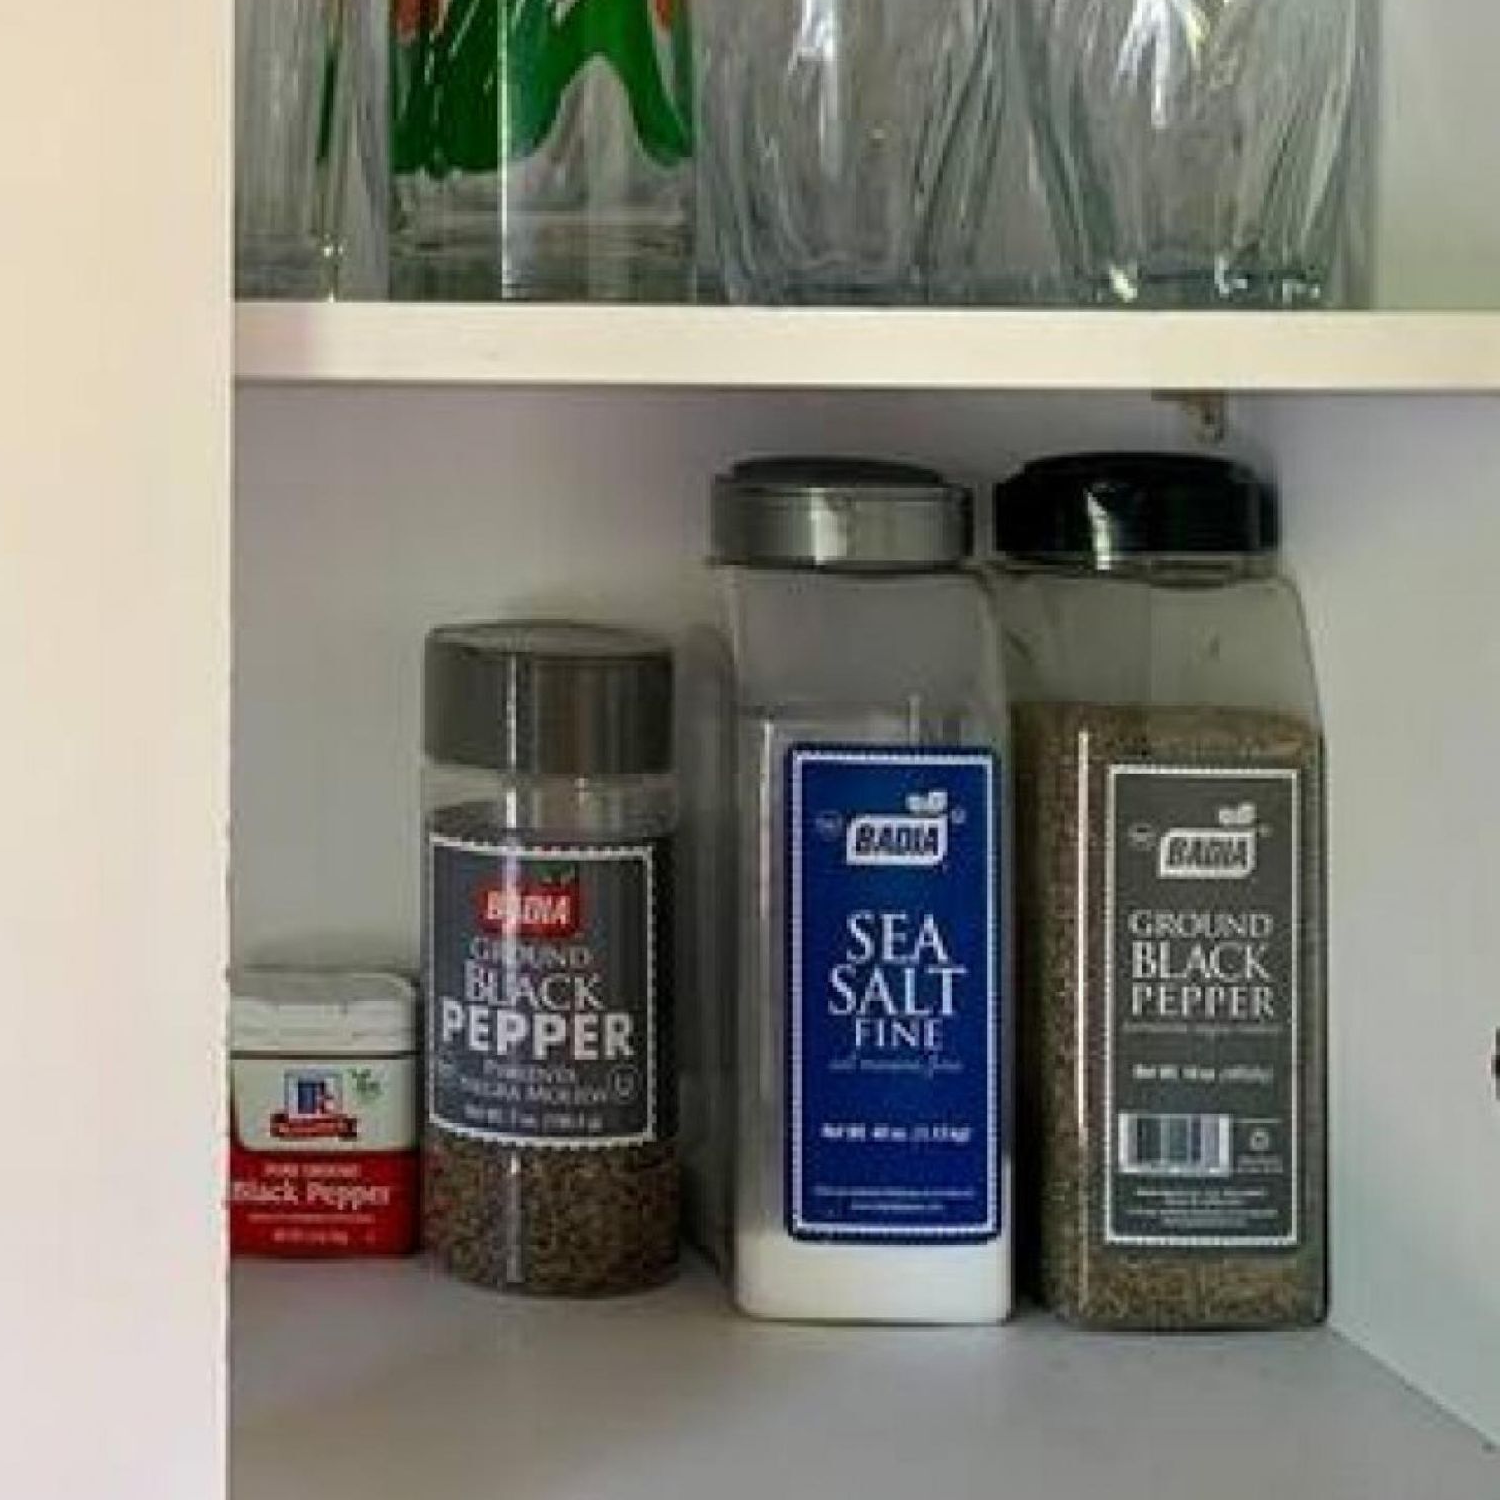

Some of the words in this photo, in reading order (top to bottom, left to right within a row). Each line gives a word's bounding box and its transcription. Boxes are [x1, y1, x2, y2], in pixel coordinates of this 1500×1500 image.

[855, 822, 940, 857] BADIA
[1167, 836, 1249, 871] BADIA
[486, 889, 572, 925] BADIA
[1127, 909, 1274, 938] GROUND
[846, 914, 950, 963] SEA
[1131, 941, 1272, 981] BLACK
[464, 960, 604, 1011] BLACK
[827, 965, 968, 1018] SALT
[1131, 983, 1275, 1019] PEPPER
[441, 1001, 636, 1060] PEPPER
[853, 1019, 945, 1051] FINE
